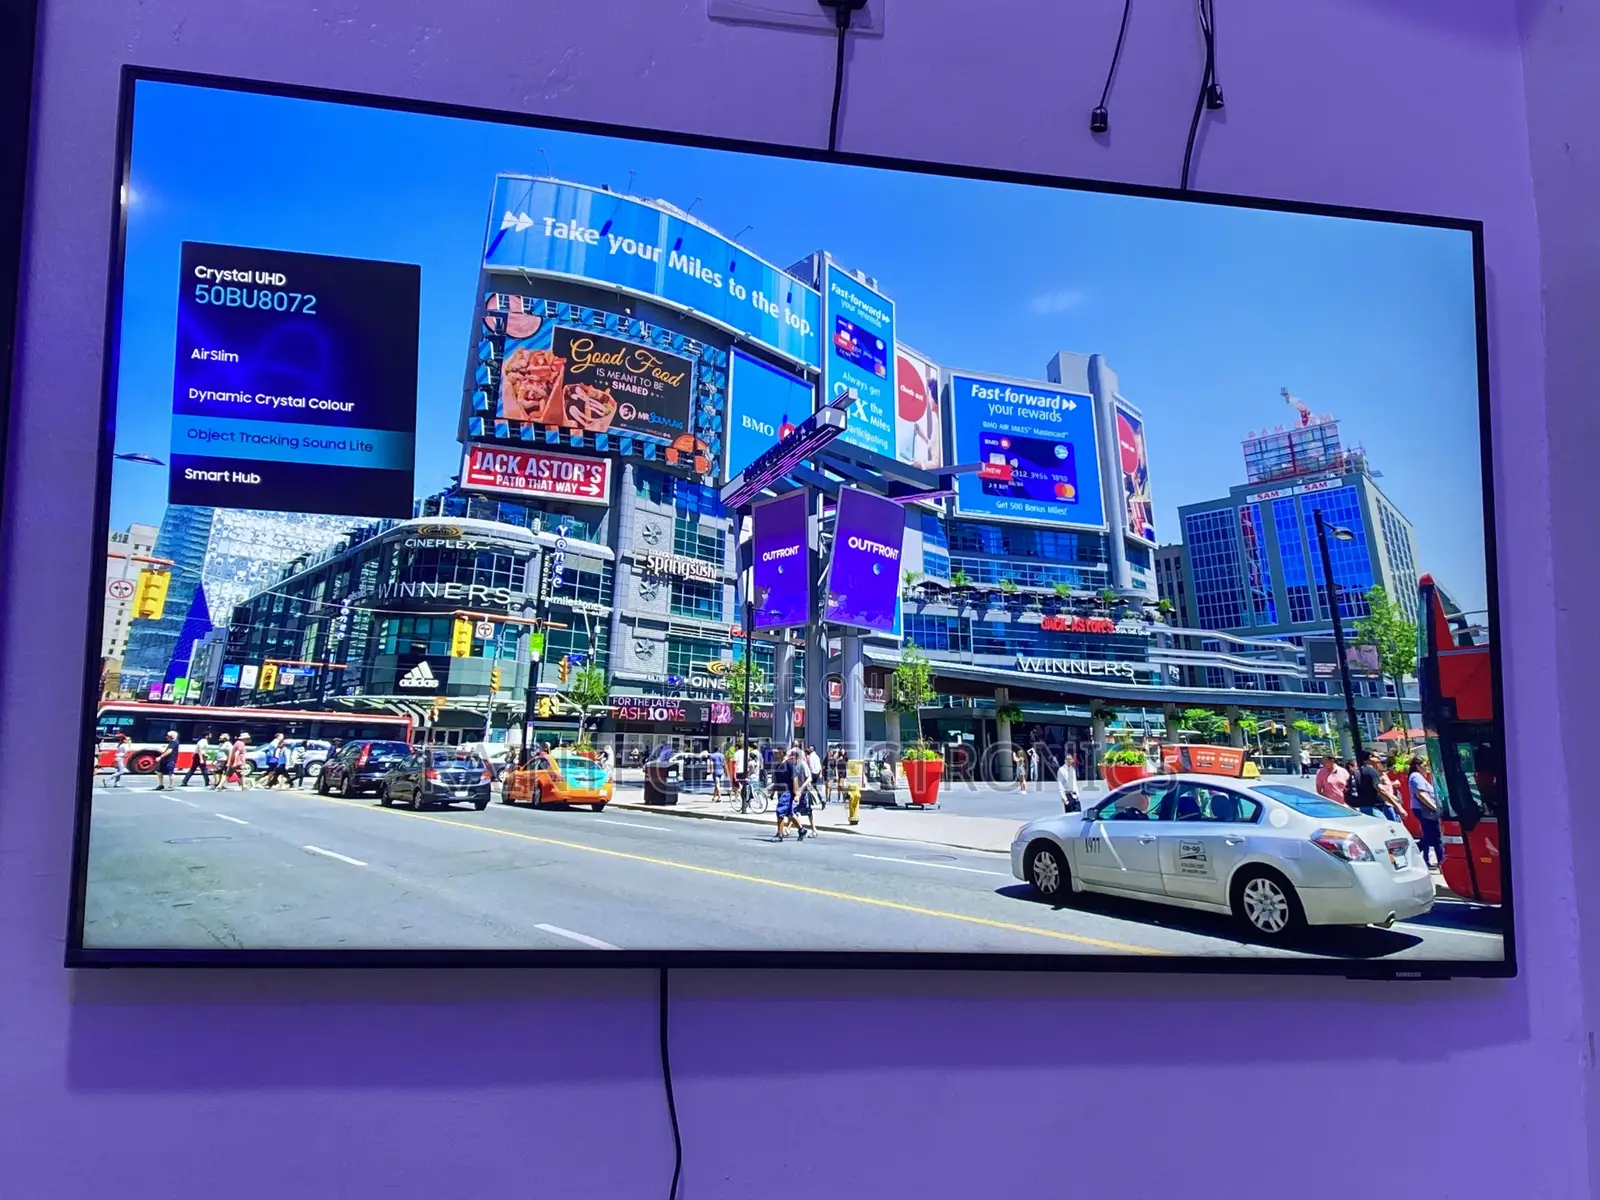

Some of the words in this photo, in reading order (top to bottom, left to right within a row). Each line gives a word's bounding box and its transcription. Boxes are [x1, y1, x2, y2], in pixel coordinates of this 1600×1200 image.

[194, 265, 252, 284] Crystal
[255, 271, 287, 286] UHD
[543, 217, 599, 245] Take
[608, 233, 662, 264] your
[668, 250, 723, 288] Miles
[729, 277, 746, 300] to
[752, 290, 779, 319] the
[784, 306, 815, 338] top.
[194, 284, 317, 314] 50BU8072
[831, 282, 882, 320] Fast-forward
[191, 348, 239, 362] AirSlim
[570, 338, 626, 373] Good
[625, 350, 685, 388] Food
[596, 368, 605, 377] IS
[607, 370, 638, 384] MEANT
[639, 377, 652, 388] TO
[653, 381, 664, 391] BE
[612, 381, 649, 396] SHARED
[842, 372, 868, 390] Always
[869, 386, 881, 396] get
[188, 388, 252, 404] Dynamic
[255, 393, 306, 409] Crystal
[308, 398, 355, 412] Colour
[971, 384, 1060, 410] Fast-forward
[870, 403, 883, 416] the
[988, 402, 1014, 416] your
[1017, 407, 1062, 423] rewards
[741, 415, 774, 437] BMO
[870, 416, 891, 432] Miles
[187, 428, 235, 443] Object
[239, 431, 299, 449] Tracking
[302, 436, 346, 450] Sound
[350, 440, 373, 452] Lite
[184, 468, 229, 482] Smart
[232, 471, 260, 484] Hub
[472, 451, 521, 475] JACK
[524, 457, 603, 484] ASTOR'S
[985, 467, 1002, 475] NEW
[496, 474, 526, 488] PATIO
[528, 478, 554, 491] THAT
[555, 481, 578, 493] WAY
[1304, 482, 1328, 491] SAM
[996, 500, 1009, 509] Get
[1256, 491, 1279, 500] SAM
[404, 538, 477, 550] CINEPLEX
[762, 545, 800, 562] OUTFRONT
[848, 536, 899, 561] OUTFRONT
[378, 581, 512, 605] WINNERS
[1018, 656, 1135, 678] WINNERS
[399, 677, 439, 688] adidas
[612, 696, 632, 706] FOR
[633, 698, 650, 707] THE
[651, 699, 681, 708] LATEST
